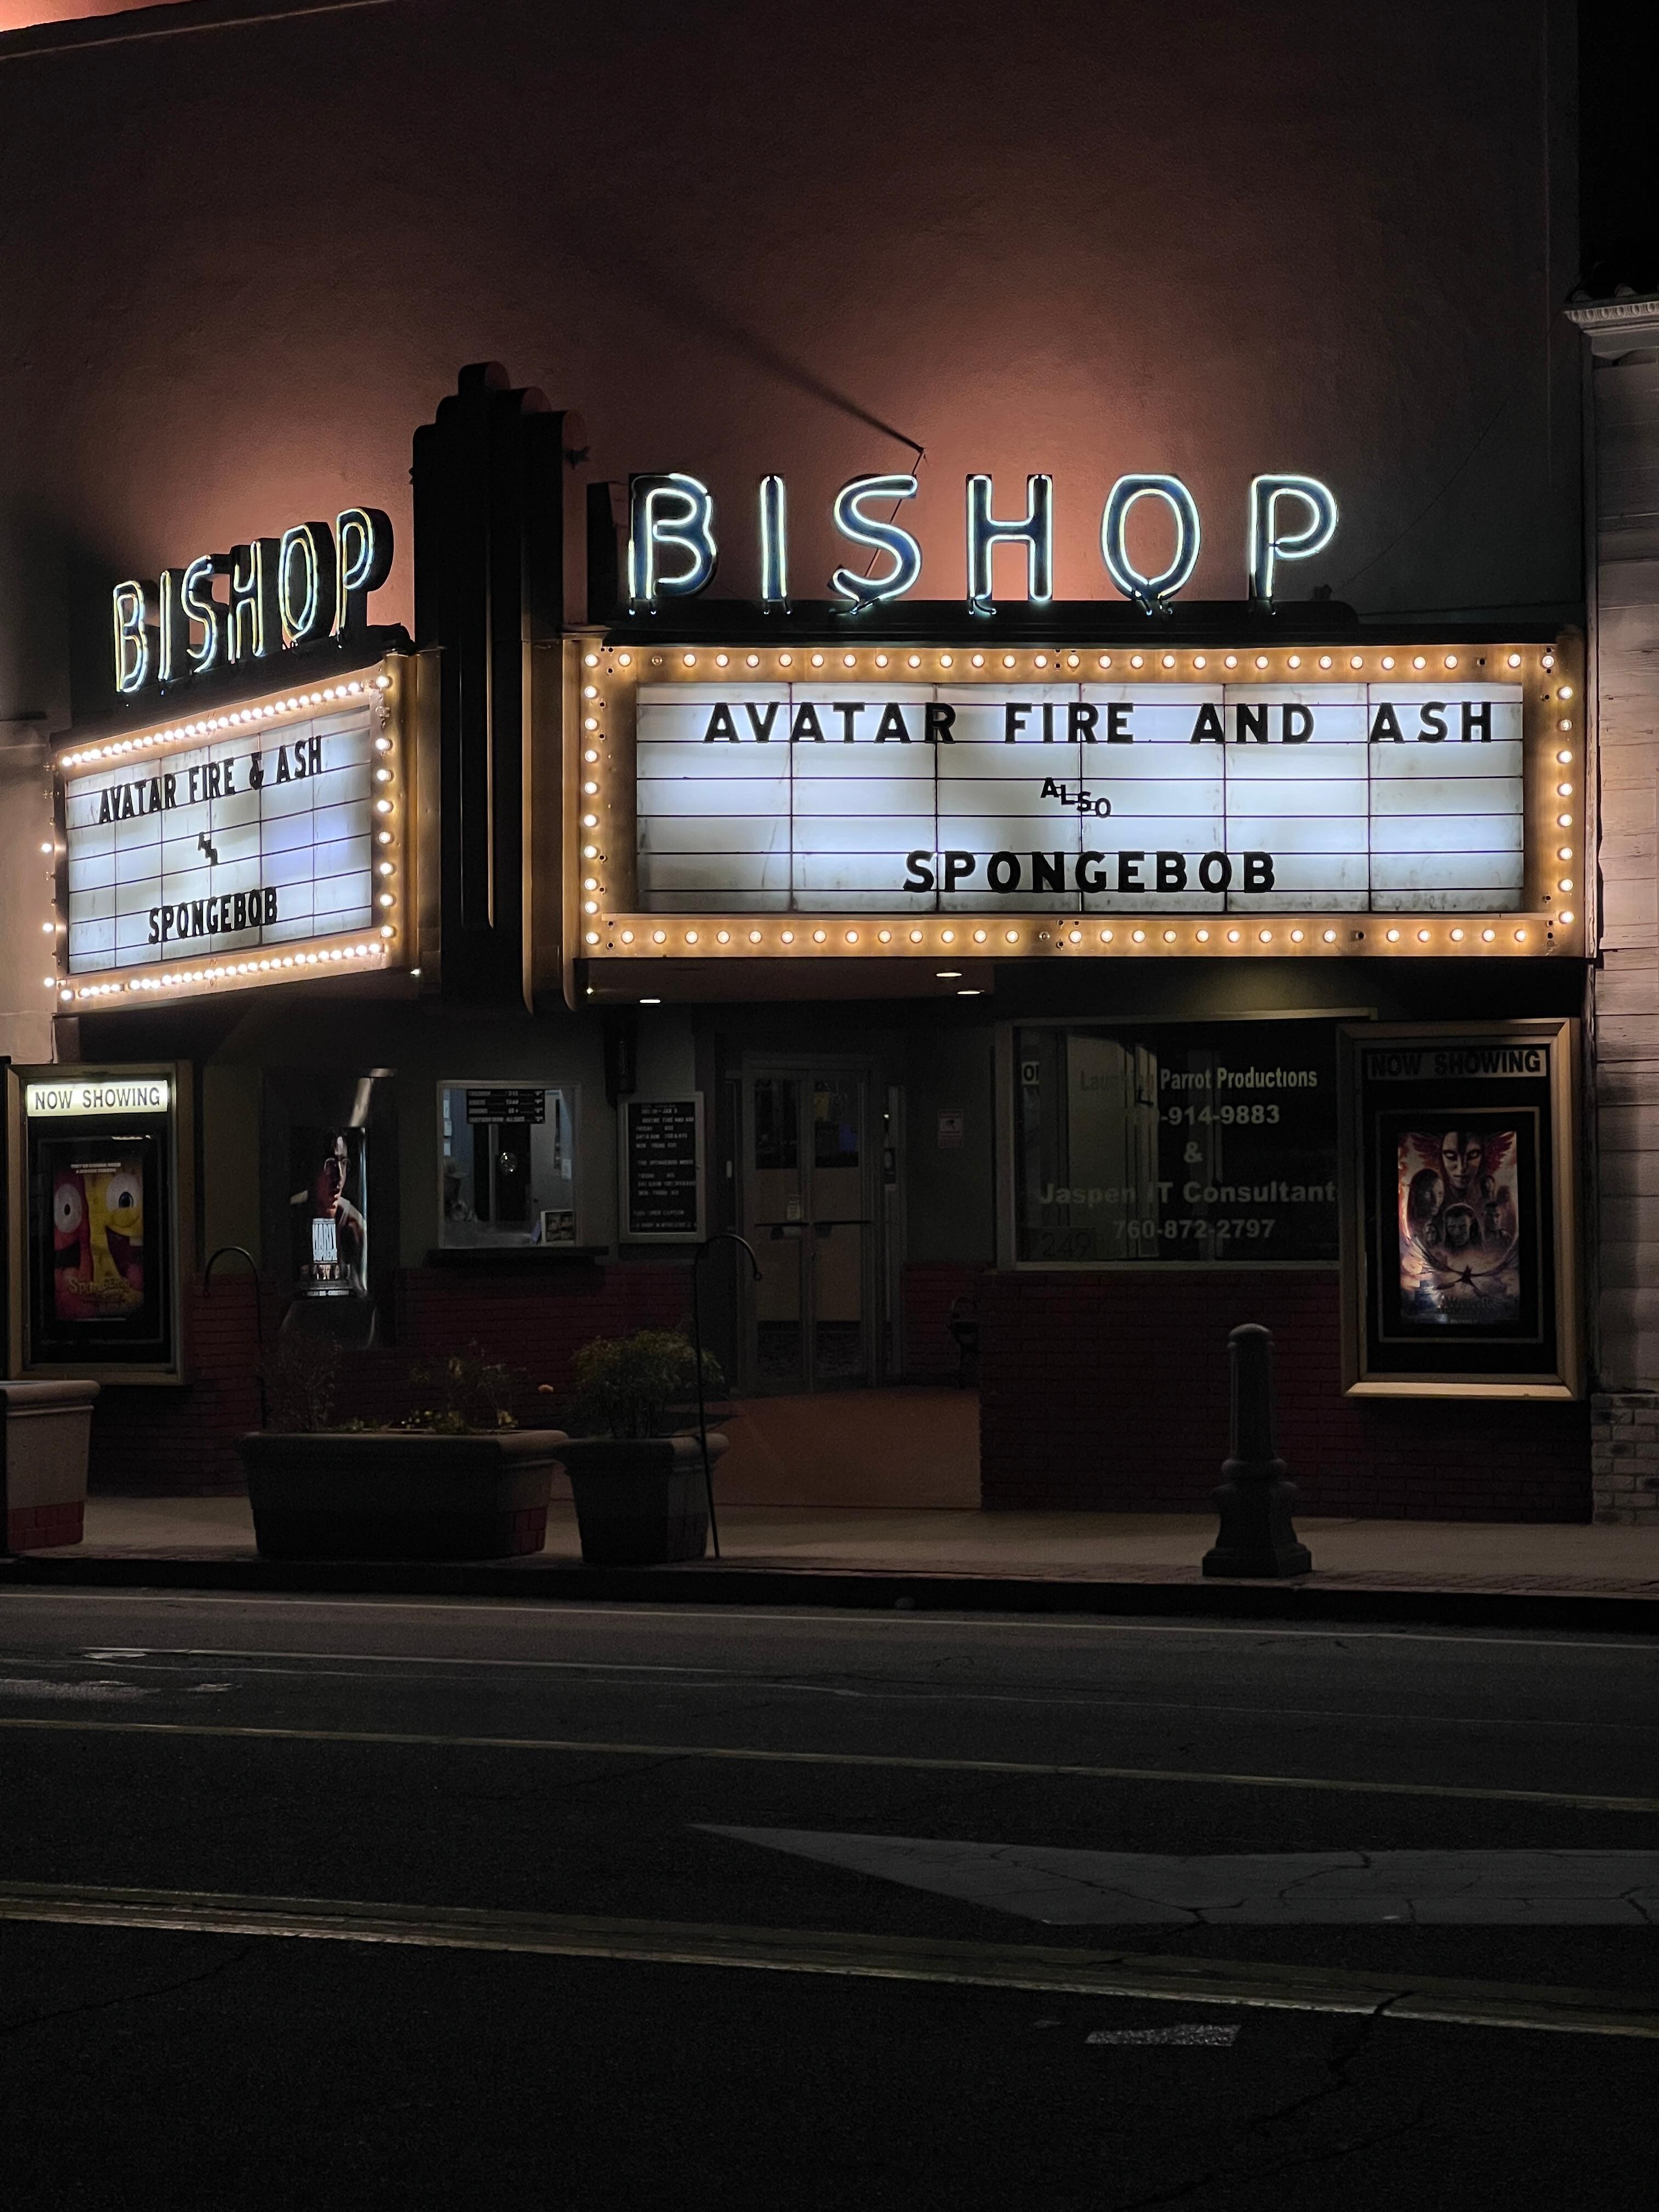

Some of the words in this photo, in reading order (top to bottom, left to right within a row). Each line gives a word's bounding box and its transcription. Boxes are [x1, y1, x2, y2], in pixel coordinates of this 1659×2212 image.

[628, 472, 1339, 601] BISHOP
[112, 507, 384, 695] BISHOP
[707, 702, 956, 744] AVATAR
[1005, 702, 1134, 744] FIRE
[1190, 701, 1314, 744] AND
[1369, 701, 1492, 743] ASH
[99, 774, 176, 823] AVATAR
[189, 758, 235, 804] FIRE
[250, 751, 263, 790] &
[277, 735, 322, 783] ASH
[1041, 777, 1111, 819] ALSO
[903, 850, 1276, 894] SPONGEBOB
[149, 887, 276, 944] SPONGEBOB
[1160, 1068, 1211, 1090] Parrot
[1217, 1066, 1317, 1090] Productions
[1372, 1052, 1423, 1076] NOW
[1435, 1048, 1541, 1076] SHOWING
[35, 1091, 72, 1109] NOW
[83, 1087, 160, 1108] SHOWING
[1126, 1104, 1280, 1126] -914-9883
[1183, 1141, 1203, 1163] &
[1042, 1183, 1135, 1207] Jaspen
[1149, 1182, 1173, 1204] IT
[1183, 1181, 1335, 1204] Consultant
[1113, 1218, 1276, 1240] 760-872-2797
